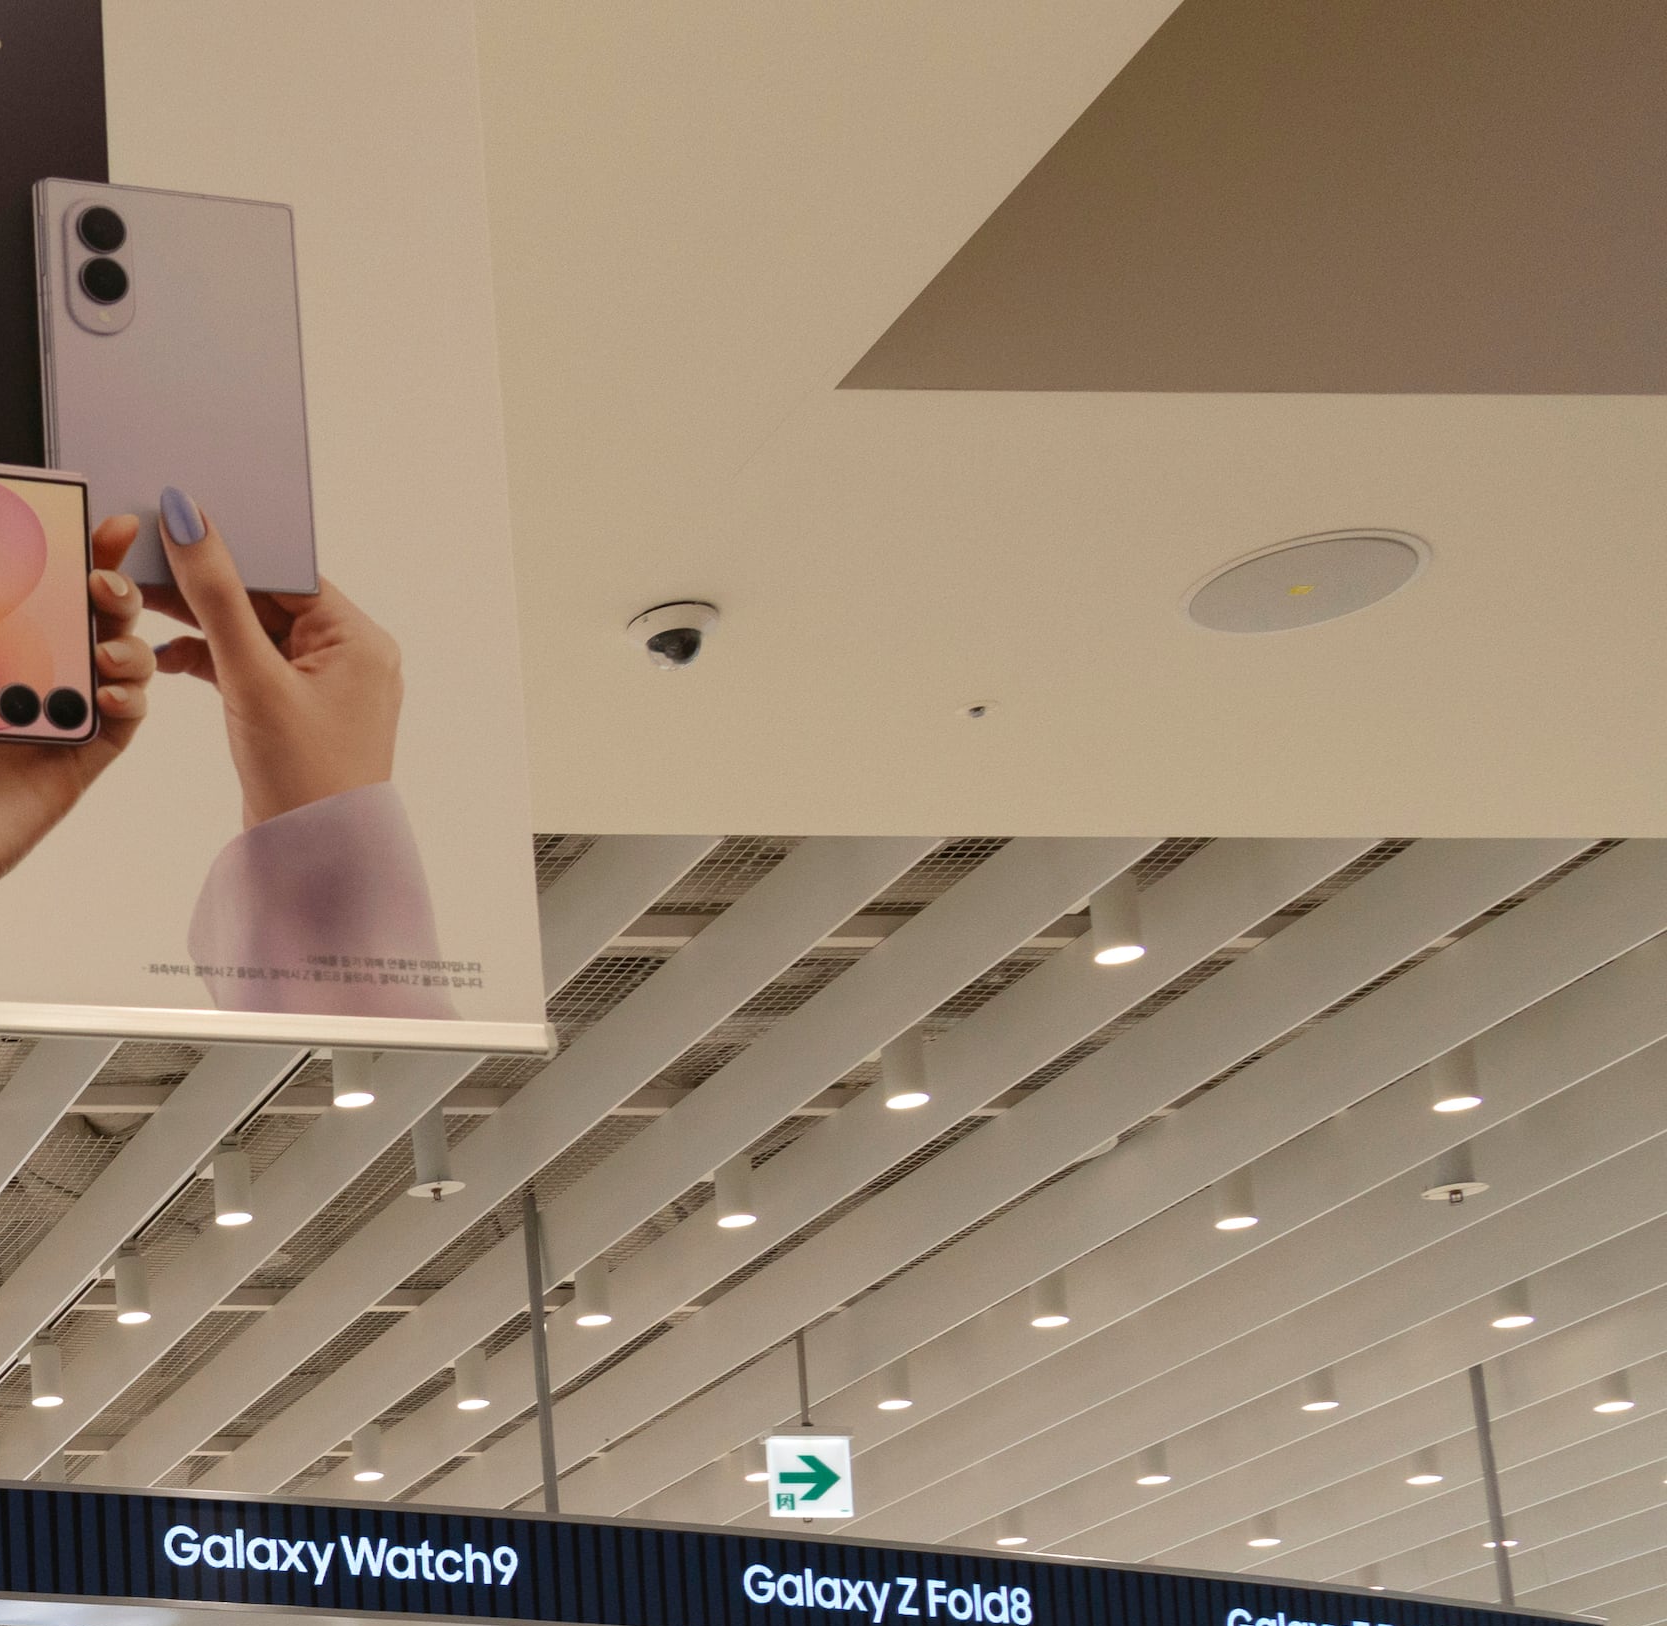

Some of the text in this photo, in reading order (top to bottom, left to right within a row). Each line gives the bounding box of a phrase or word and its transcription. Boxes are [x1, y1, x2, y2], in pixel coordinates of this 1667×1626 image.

[164, 1526, 517, 1585] Galaxy Watch9
[744, 1565, 1031, 1625] Galaxy Z Fold8
